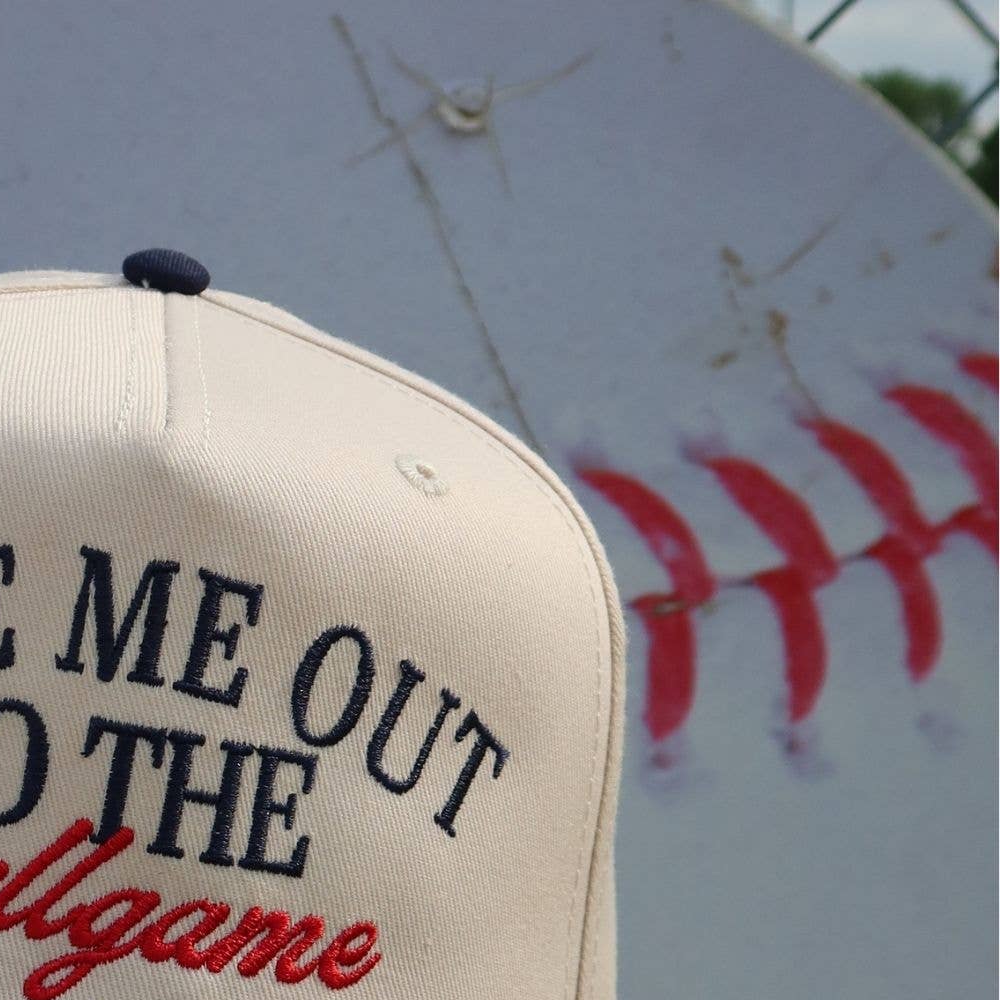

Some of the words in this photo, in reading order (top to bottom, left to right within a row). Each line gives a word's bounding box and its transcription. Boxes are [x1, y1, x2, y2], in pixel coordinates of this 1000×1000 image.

[54, 544, 265, 710] ME
[288, 623, 512, 839] OUT
[80, 714, 320, 880] THE
